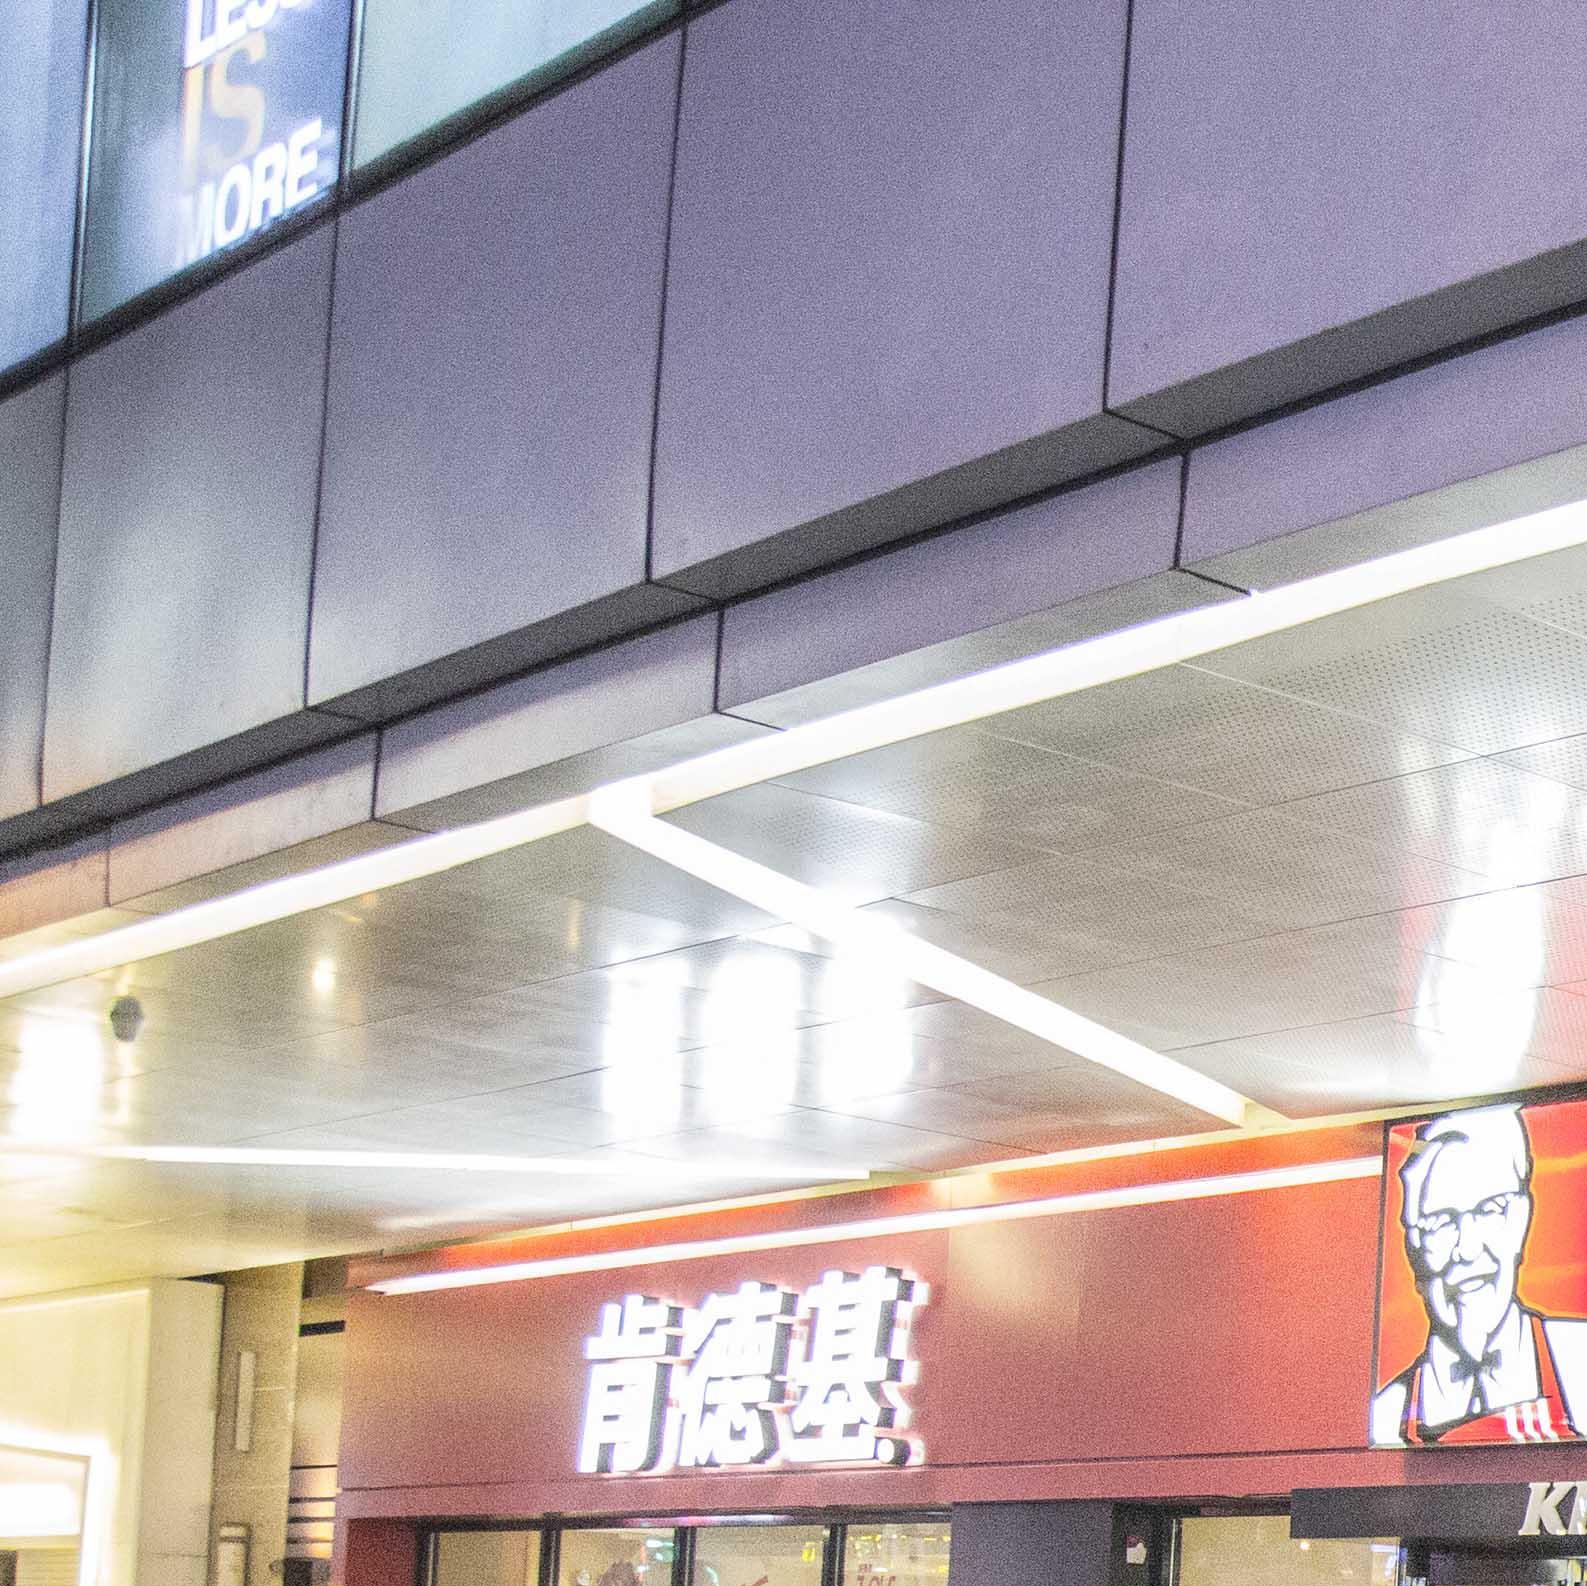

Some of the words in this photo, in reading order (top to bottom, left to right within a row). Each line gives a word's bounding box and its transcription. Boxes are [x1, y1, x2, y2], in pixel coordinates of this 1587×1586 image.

[182, 32, 265, 200] IS
[182, 119, 322, 264] MORE
[576, 1270, 910, 1474] 肯德基
